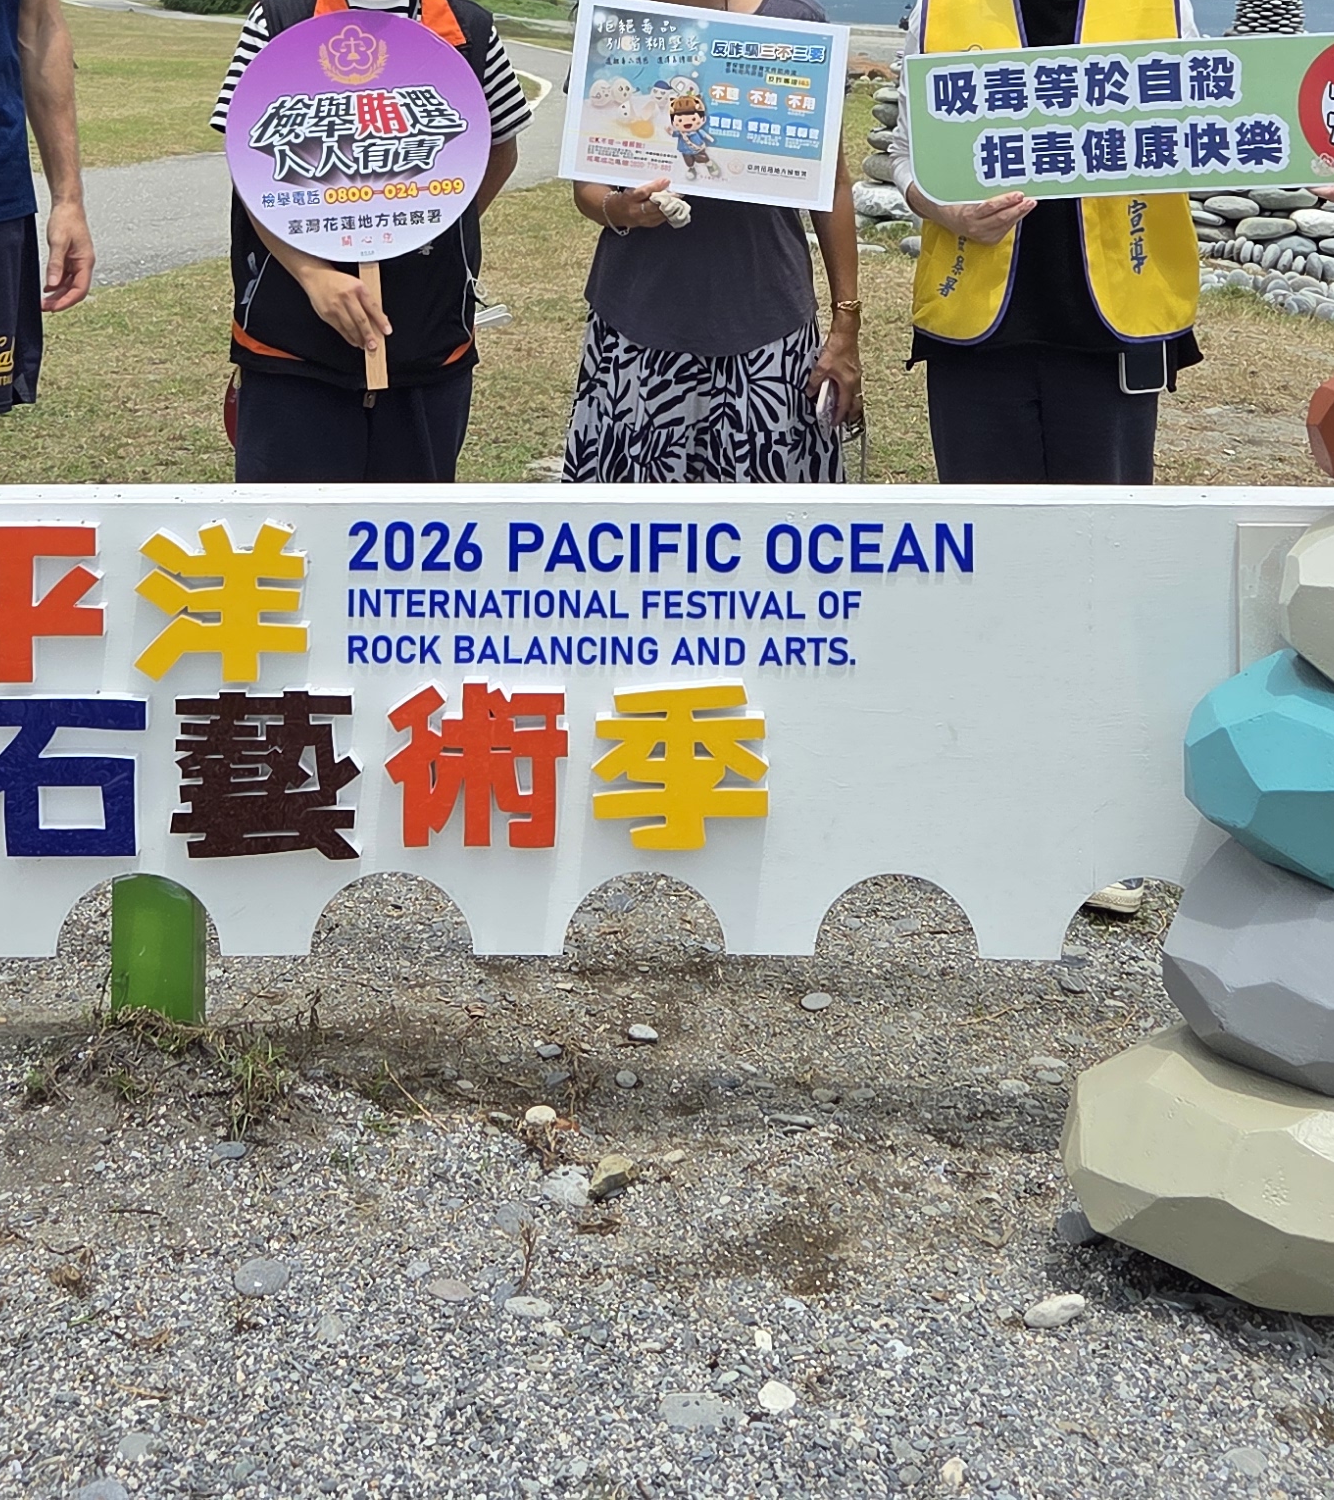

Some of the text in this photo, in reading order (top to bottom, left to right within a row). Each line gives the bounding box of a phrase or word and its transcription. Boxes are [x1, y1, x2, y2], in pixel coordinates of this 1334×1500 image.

[933, 55, 1235, 115] 吸毒等於自殺
[250, 88, 466, 145] 檢舉賄選
[275, 137, 441, 179] 人人有責
[980, 120, 1283, 181] 拒毒健康快樂
[262, 179, 464, 208] 檢舉電話 0800-024-099
[288, 209, 442, 234] 臺灣花蓮地方檢察署
[347, 521, 974, 573] 2026 PACIFIC OCEAN
[347, 589, 862, 620] INTERNATIONAL FESTIVAL OF
[347, 635, 856, 667] ROCK BALANCING AND ARTS.
